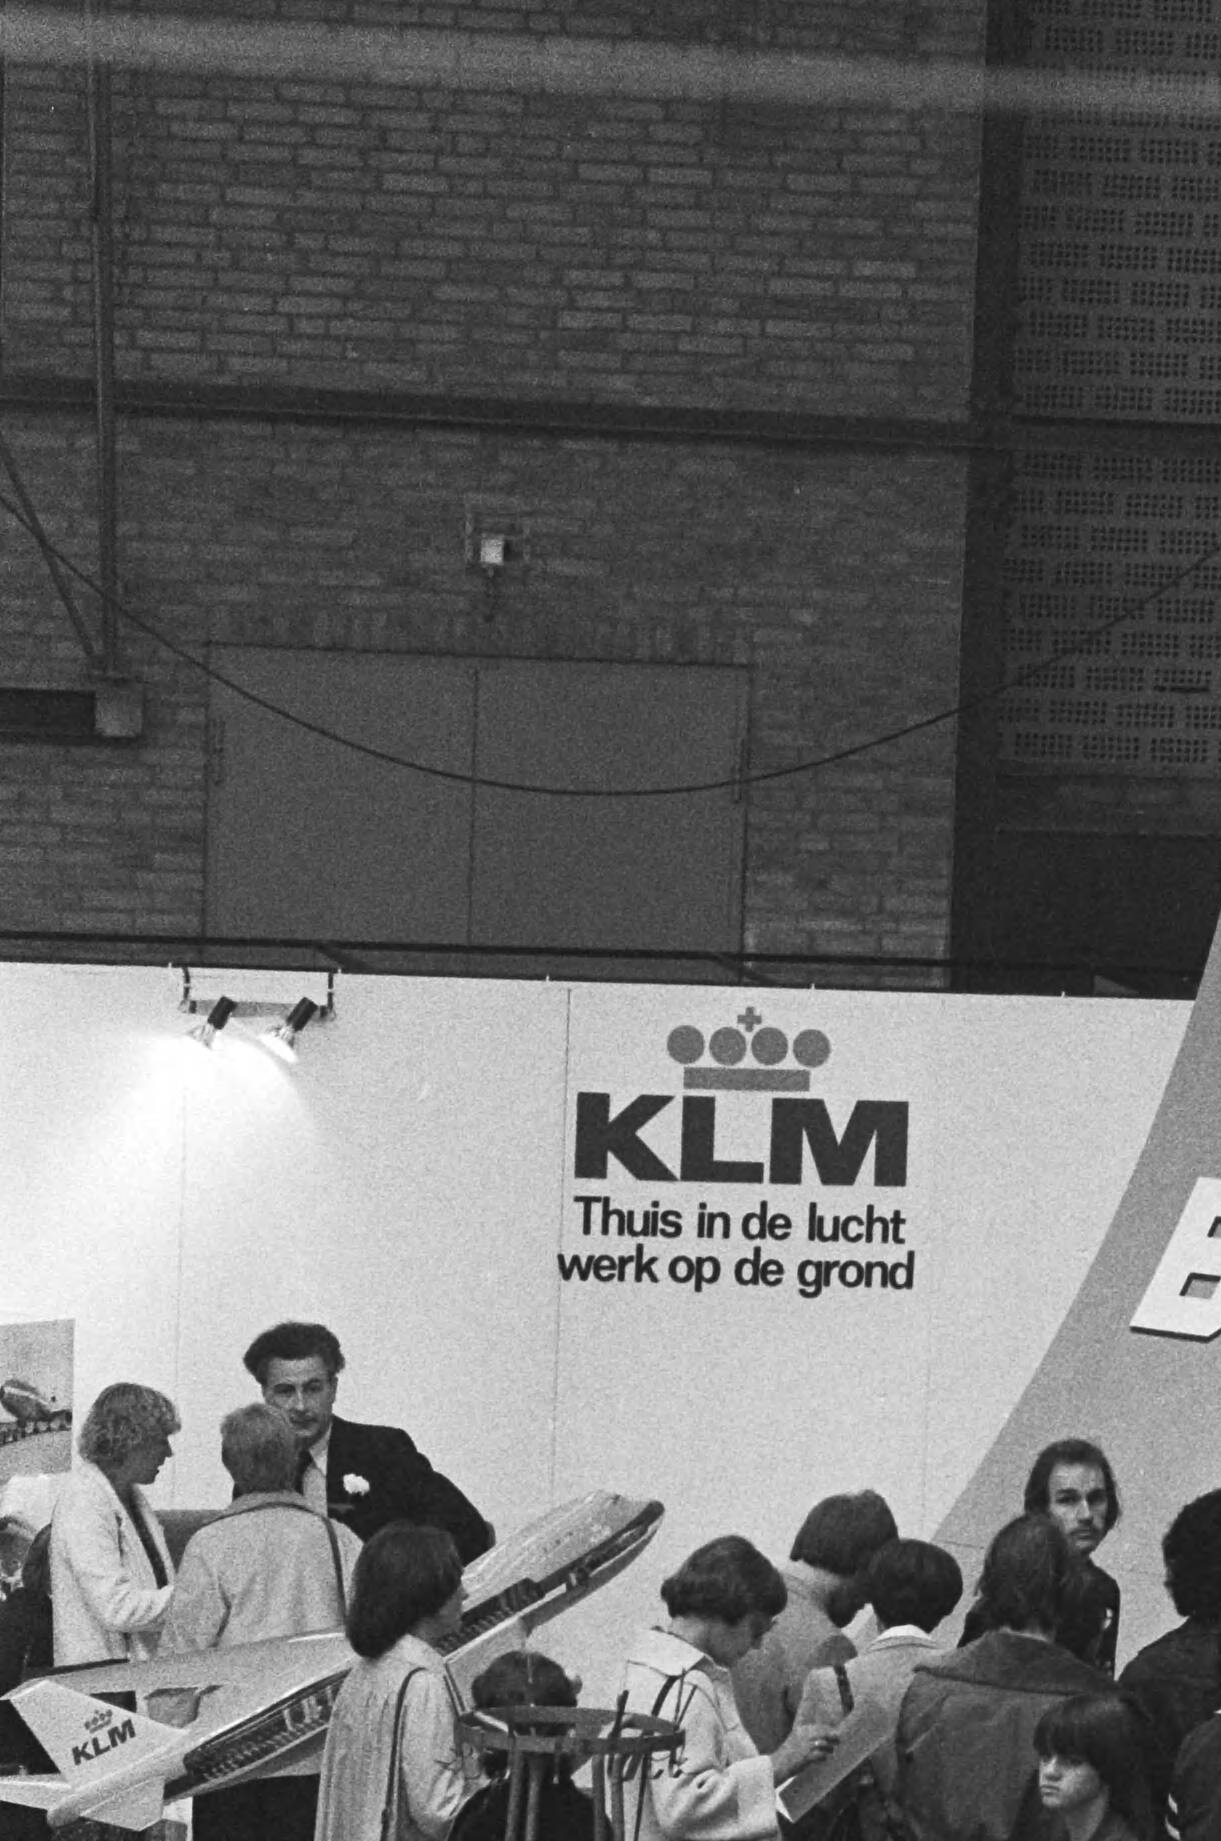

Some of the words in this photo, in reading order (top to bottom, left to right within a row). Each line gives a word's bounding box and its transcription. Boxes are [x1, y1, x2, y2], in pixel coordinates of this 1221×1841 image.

[574, 1092, 909, 1187] KLM
[573, 1195, 683, 1239] Thuis
[696, 1201, 731, 1240] in
[741, 1200, 793, 1241] de
[807, 1201, 906, 1245] lucht
[557, 1243, 659, 1284] werk
[667, 1255, 722, 1293] op
[733, 1245, 785, 1288] de
[797, 1250, 916, 1299] grond
[72, 1718, 136, 1765] KLM
